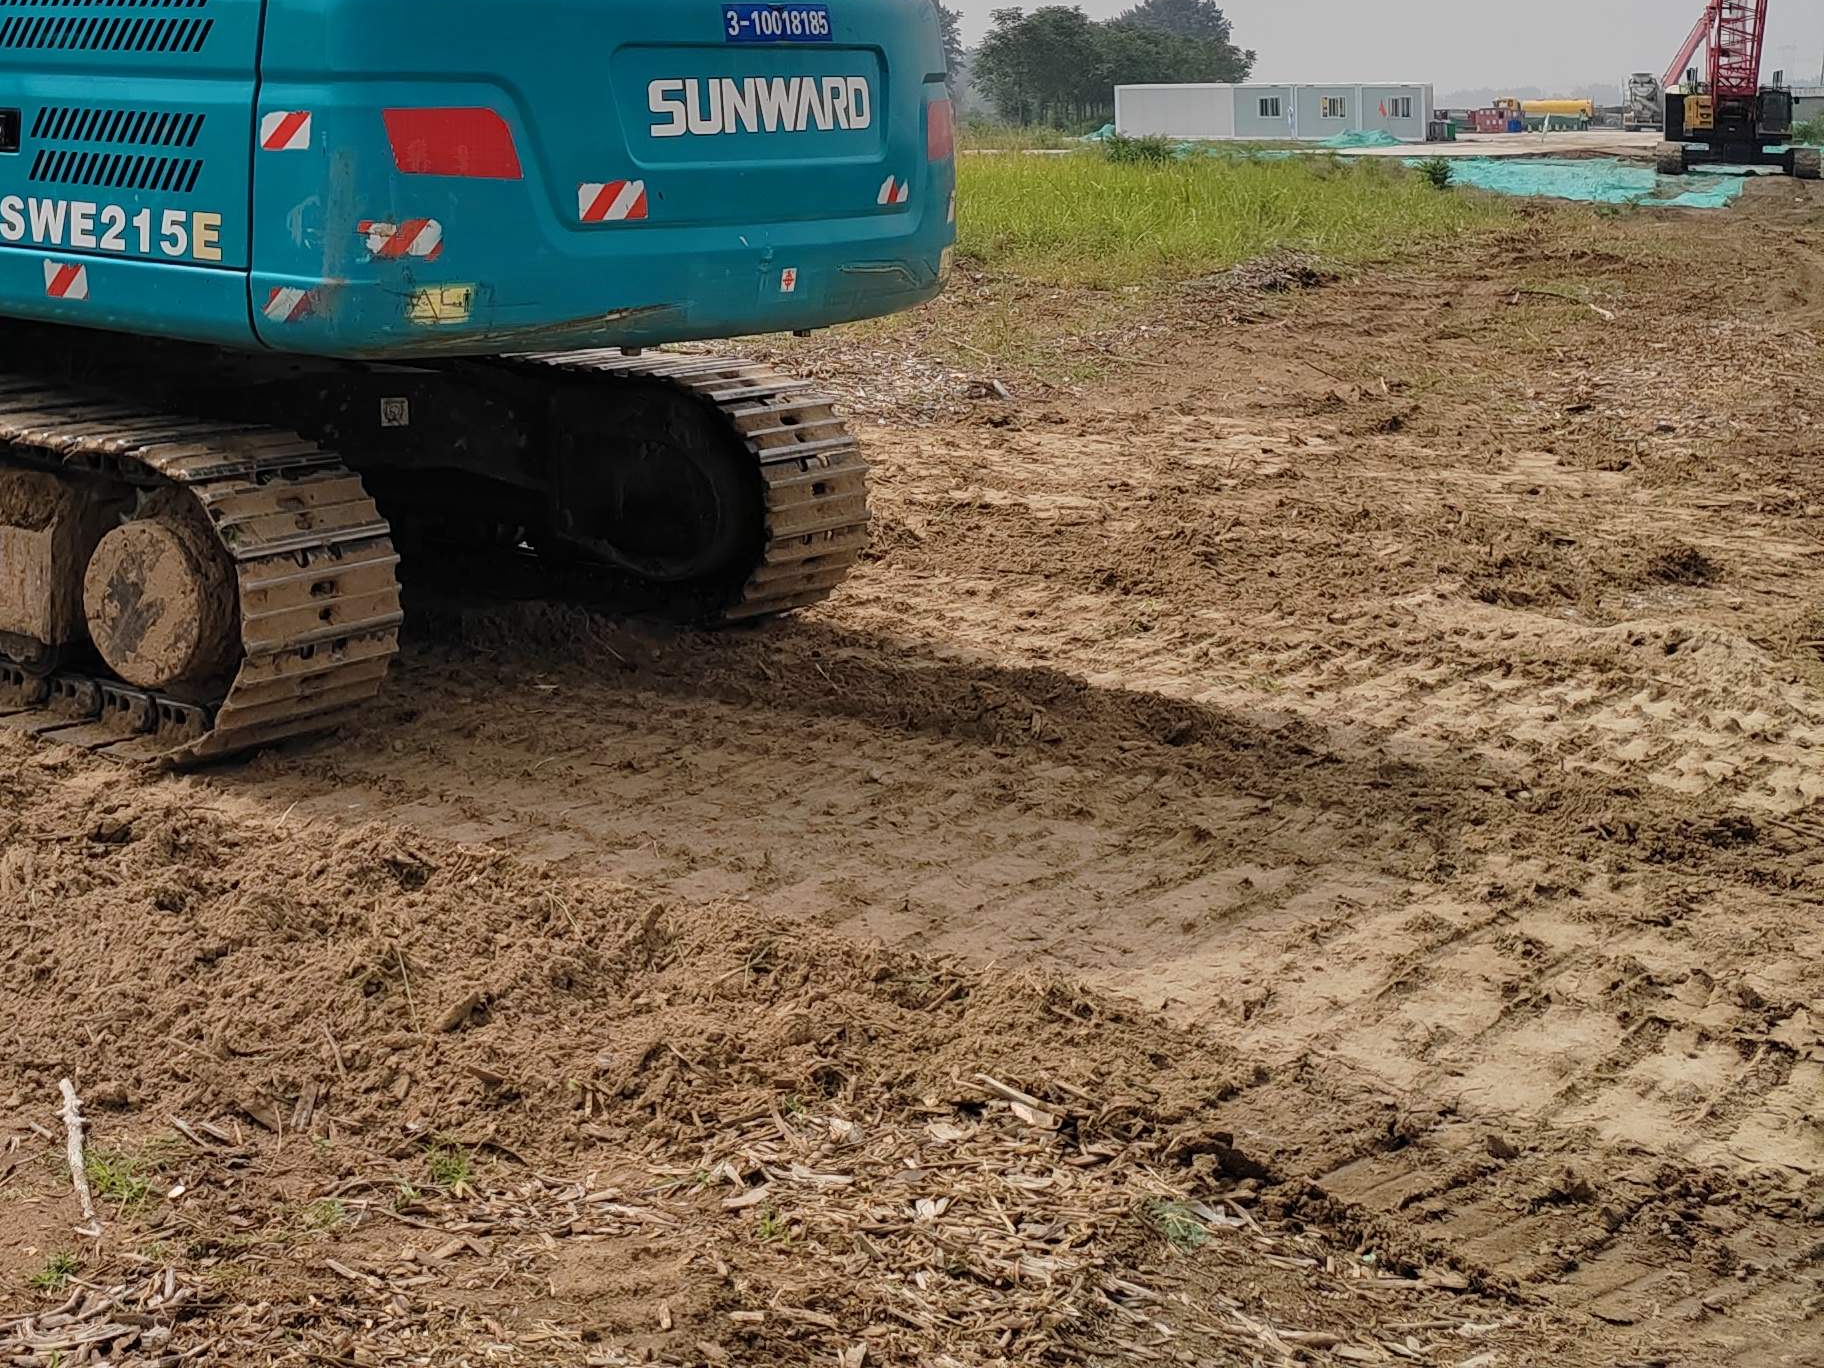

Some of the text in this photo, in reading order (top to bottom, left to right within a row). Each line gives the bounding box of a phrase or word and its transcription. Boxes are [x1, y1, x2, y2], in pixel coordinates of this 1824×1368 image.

[727, 10, 828, 36] 3-10018185
[648, 76, 871, 137] SUNWARD
[0, 194, 222, 261] SWE215E
